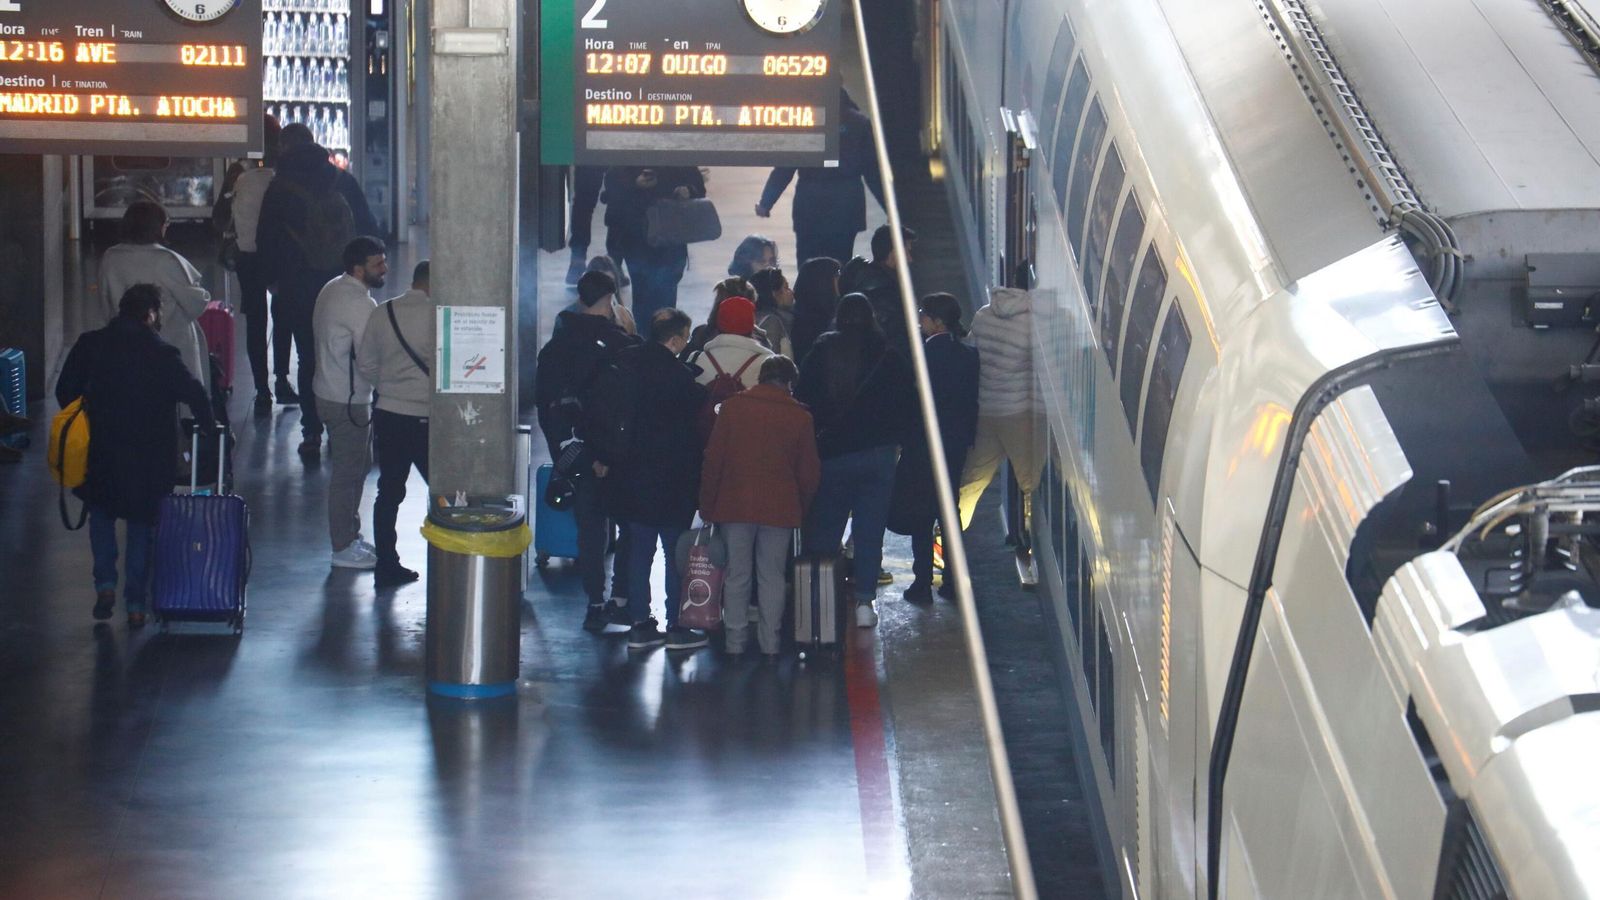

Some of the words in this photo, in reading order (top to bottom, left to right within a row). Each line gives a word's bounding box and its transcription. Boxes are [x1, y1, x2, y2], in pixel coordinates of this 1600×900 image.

[195, 4, 206, 15] 6
[581, 0, 608, 29] 2
[777, 16, 787, 26] 6
[75, 25, 104, 37] Tren
[585, 38, 614, 50] Hora
[629, 42, 648, 50] TIME
[0, 41, 65, 62] 12:16
[75, 42, 116, 63] AVE
[181, 45, 246, 66] 02111
[586, 53, 652, 74] 12:07
[662, 54, 727, 75] OUIGO
[763, 55, 827, 76] 06529
[585, 88, 632, 100] Destino
[647, 93, 693, 102] DESTINATION
[0, 92, 80, 114] MADRID
[90, 94, 140, 116] PTA.
[156, 95, 237, 118] ATOCHA
[586, 104, 664, 125] MADRID
[675, 105, 722, 126] PTA.
[738, 105, 815, 127] ATOCHA
